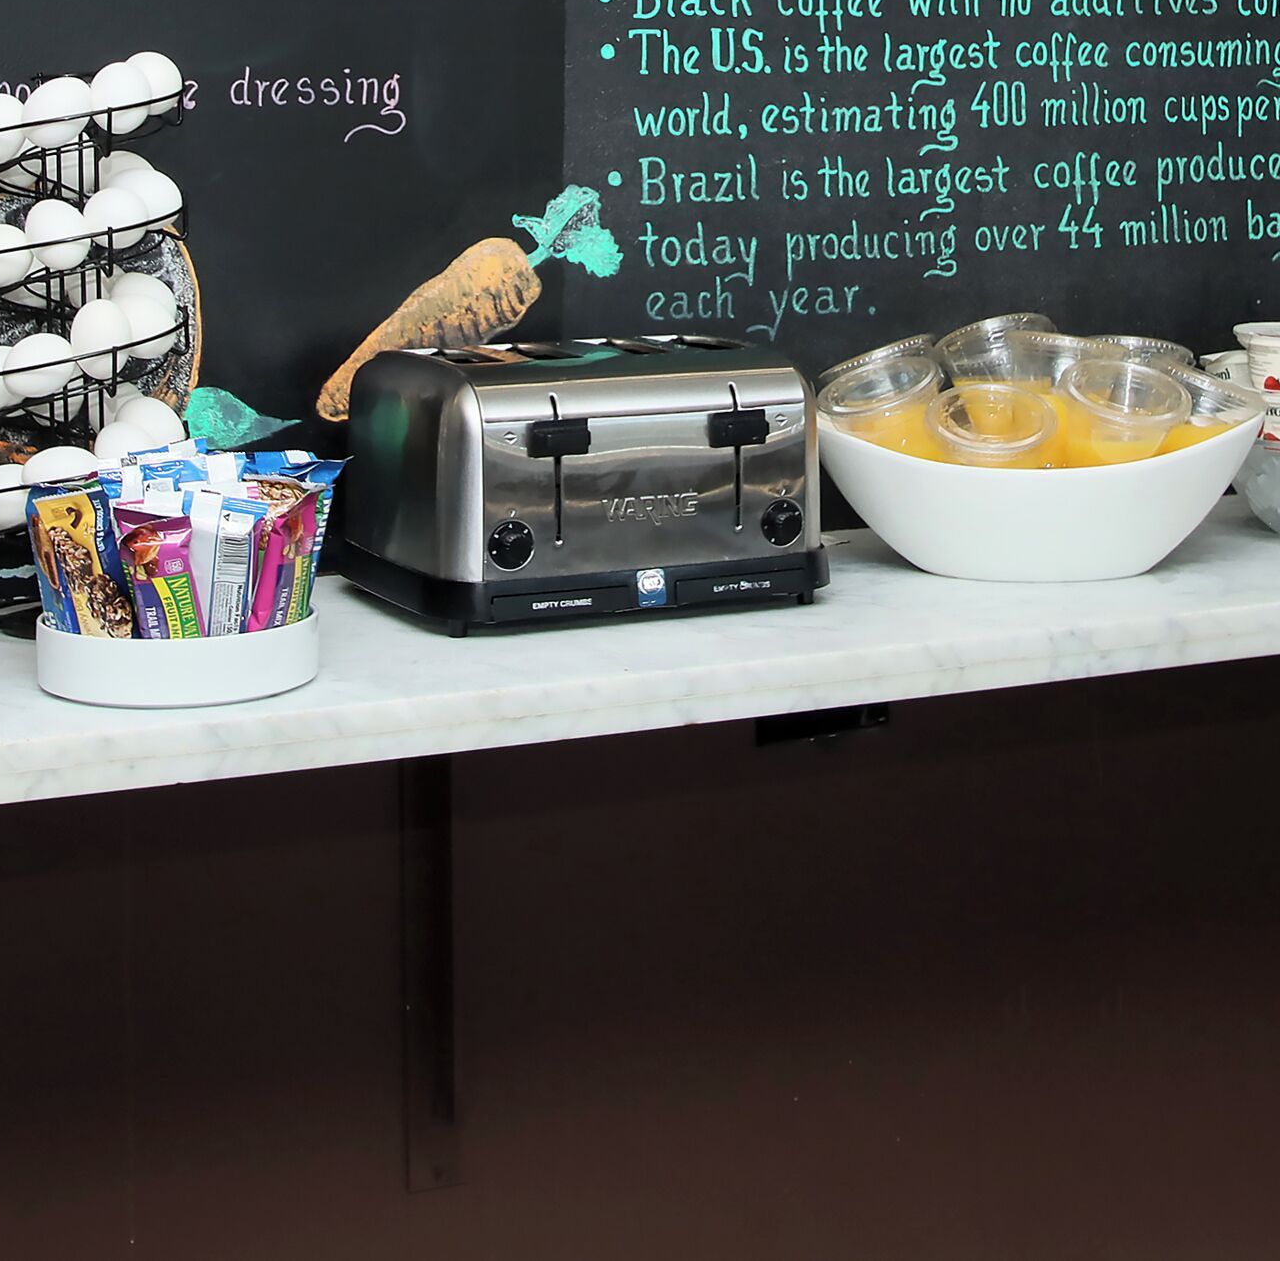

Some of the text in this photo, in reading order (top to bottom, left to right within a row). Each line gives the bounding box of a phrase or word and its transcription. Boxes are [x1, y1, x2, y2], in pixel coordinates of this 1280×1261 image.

[628, 28, 701, 76] The
[783, 36, 809, 75] is
[817, 35, 868, 74] the
[884, 30, 1001, 95] largest
[1015, 31, 1109, 84] coffee
[230, 66, 407, 143] dressing
[633, 90, 748, 140] world,
[761, 91, 959, 156] estimating
[970, 80, 1027, 129] 400
[1040, 82, 1148, 128] million
[1164, 92, 1231, 136] cups
[638, 153, 761, 207] Brazil
[781, 159, 809, 201] is
[817, 156, 871, 199] the
[887, 156, 1010, 221] largest
[1033, 151, 1138, 206] coffee
[638, 221, 758, 287] today
[785, 218, 958, 281] producing
[974, 221, 1046, 253] over
[1057, 202, 1105, 250] 44
[1119, 202, 1229, 247] million
[646, 274, 877, 341] each year.
[601, 491, 699, 526] WARING
[163, 596, 179, 623] FRUIT
[167, 577, 195, 622] NATURE
